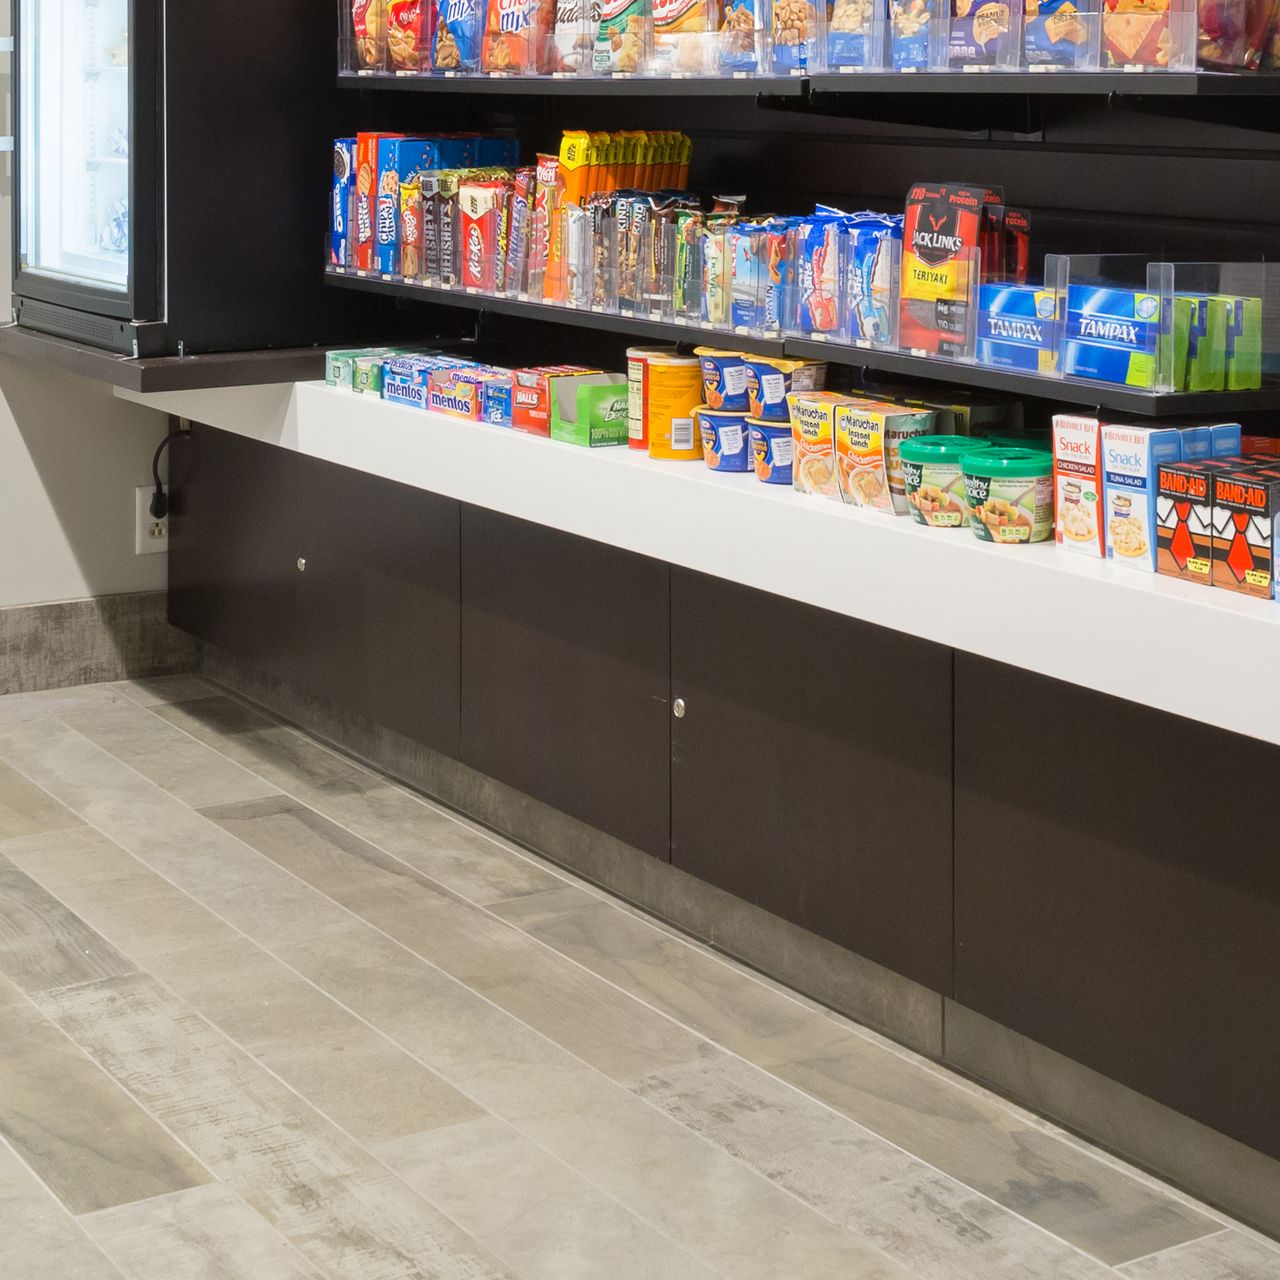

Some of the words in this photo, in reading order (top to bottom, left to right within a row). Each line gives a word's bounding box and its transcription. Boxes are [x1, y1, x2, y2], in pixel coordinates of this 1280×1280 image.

[911, 187, 926, 199] 110
[949, 195, 978, 206] Protein
[333, 183, 344, 234] OREO
[618, 200, 626, 233] KIND
[633, 204, 644, 235] KIND
[912, 229, 933, 249] JACK
[932, 231, 962, 251] LINK'S
[913, 268, 948, 285] TERIYAKI
[987, 318, 1042, 343] TAMPAX
[1079, 318, 1139, 344] TAMPAX
[450, 372, 479, 384] mentos
[386, 381, 422, 402] mentos
[515, 390, 539, 406] HALLS
[431, 391, 471, 414] mentos
[796, 403, 828, 421] Maruchan
[799, 419, 821, 430] Instant
[801, 427, 819, 437] Lunch
[846, 415, 879, 432] Maruchan
[1060, 420, 1082, 431] BUMBLE
[1083, 423, 1095, 432] BEE
[848, 428, 871, 441] Instant
[1108, 431, 1132, 442] BUMBLE
[1134, 434, 1145, 444] BEE
[850, 438, 869, 449] Lunch
[1059, 436, 1091, 455] Snack
[1108, 448, 1142, 468] Snack
[1057, 461, 1079, 471] CHICKEN
[1079, 464, 1095, 474] SALAD
[1110, 474, 1124, 483] TUNA
[1125, 476, 1142, 485] SALAD
[1159, 470, 1207, 498] BAND-AID
[1215, 483, 1266, 508] BAND-AID
